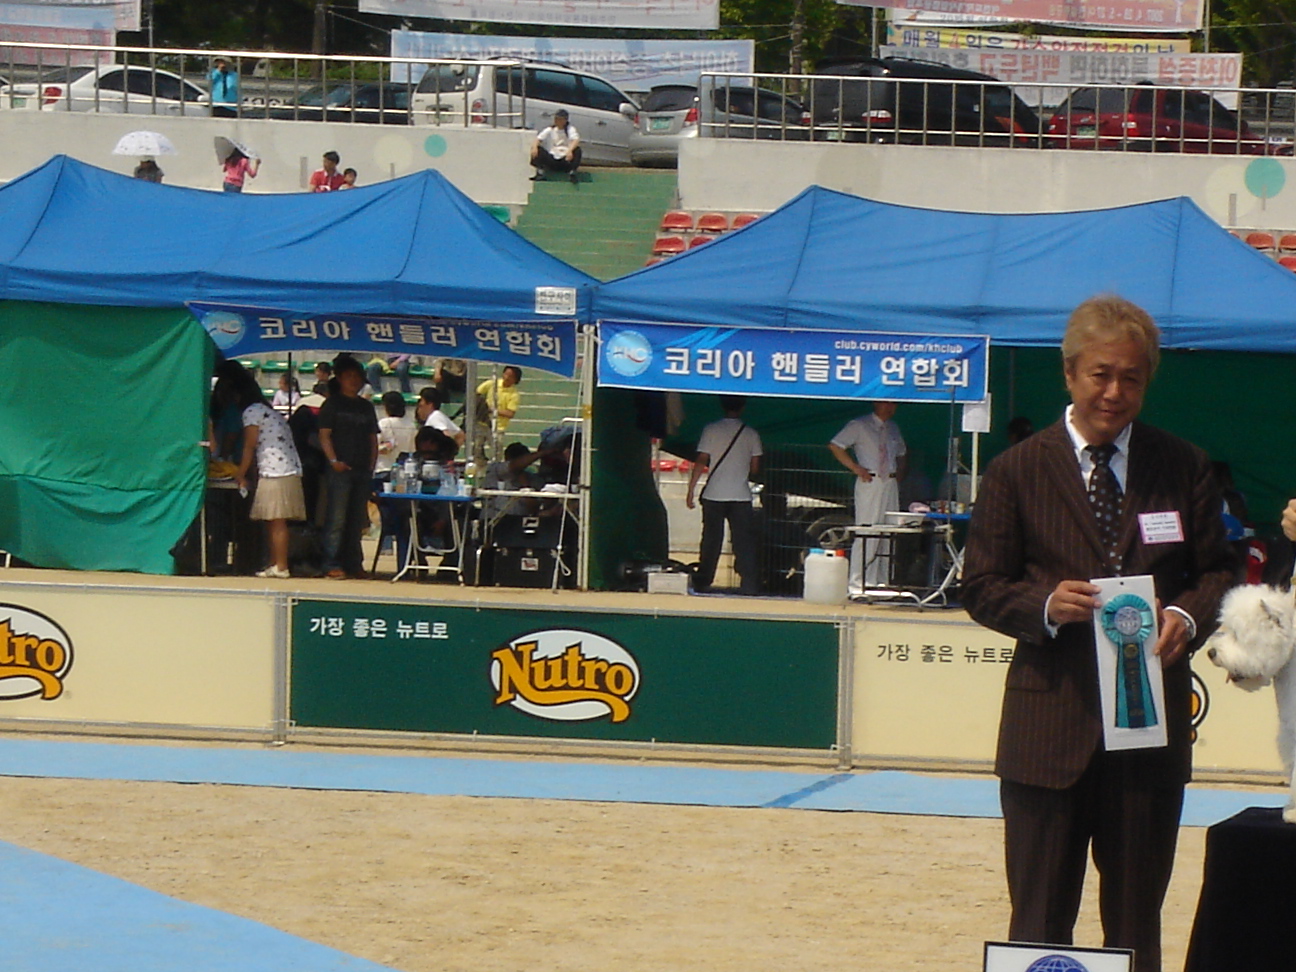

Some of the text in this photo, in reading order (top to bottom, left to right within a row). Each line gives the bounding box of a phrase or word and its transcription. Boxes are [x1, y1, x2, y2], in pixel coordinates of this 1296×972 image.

[903, 29, 940, 48] 매월
[259, 316, 350, 341] 코리아
[366, 322, 457, 348] 핸들러
[474, 327, 562, 361] 연합회
[834, 339, 964, 354] club.cyworld.com/khclub
[663, 346, 969, 388] 코리아 핸들러 연합회
[310, 618, 449, 639] 가장 좋은 뉴트로
[0, 617, 65, 676] tro
[877, 643, 1015, 664] 가장 좋은 뉴트로
[491, 640, 635, 714] Nutro
